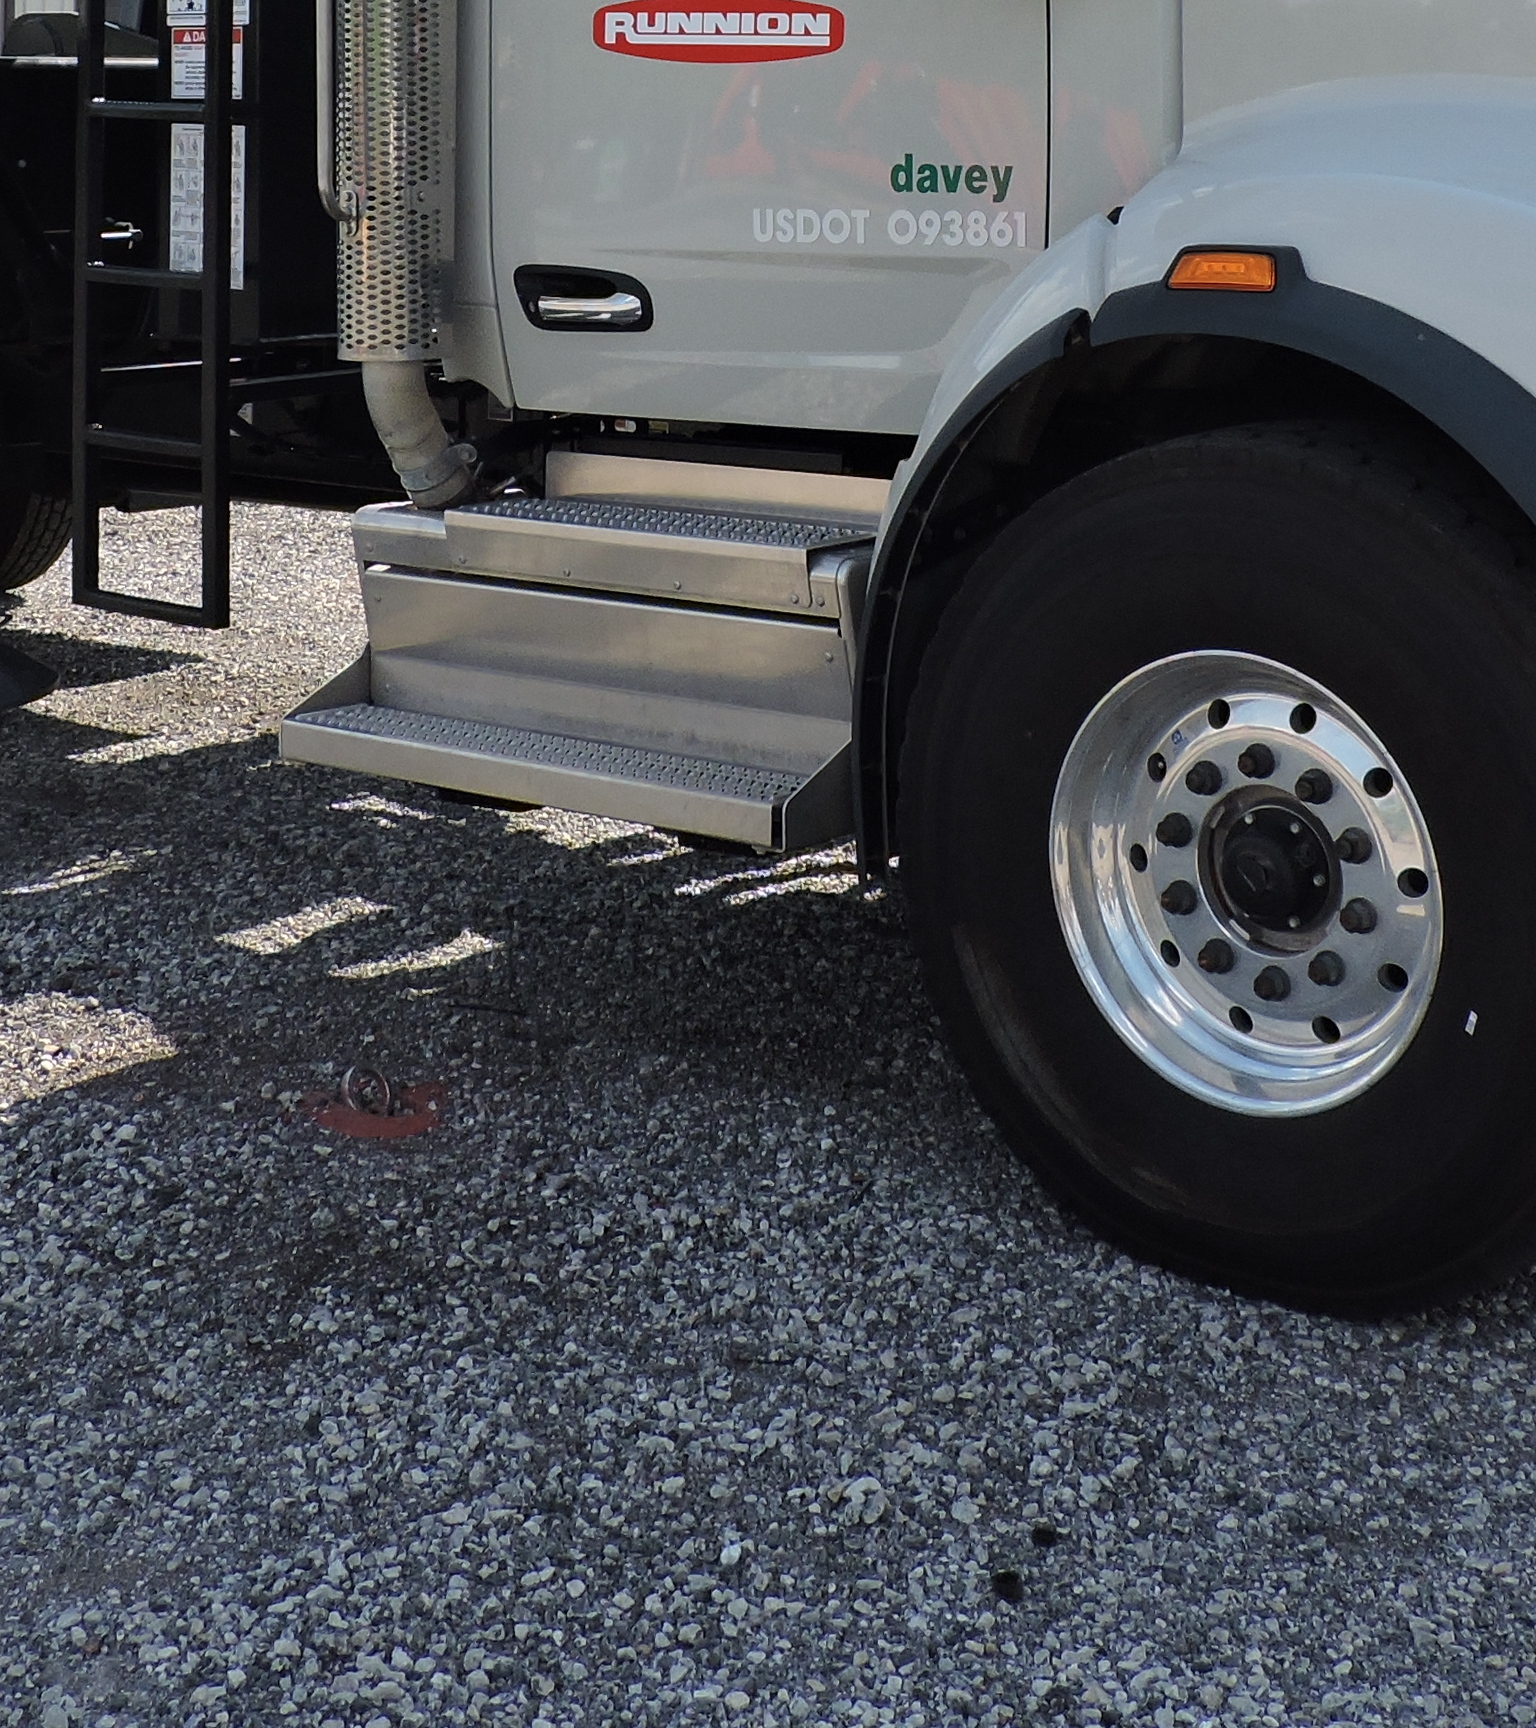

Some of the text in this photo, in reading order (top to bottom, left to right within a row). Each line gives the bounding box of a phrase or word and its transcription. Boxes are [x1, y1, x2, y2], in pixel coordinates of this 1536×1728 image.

[604, 12, 831, 46] RUNNION
[890, 153, 1013, 202] davey
[752, 208, 870, 243] USDOT
